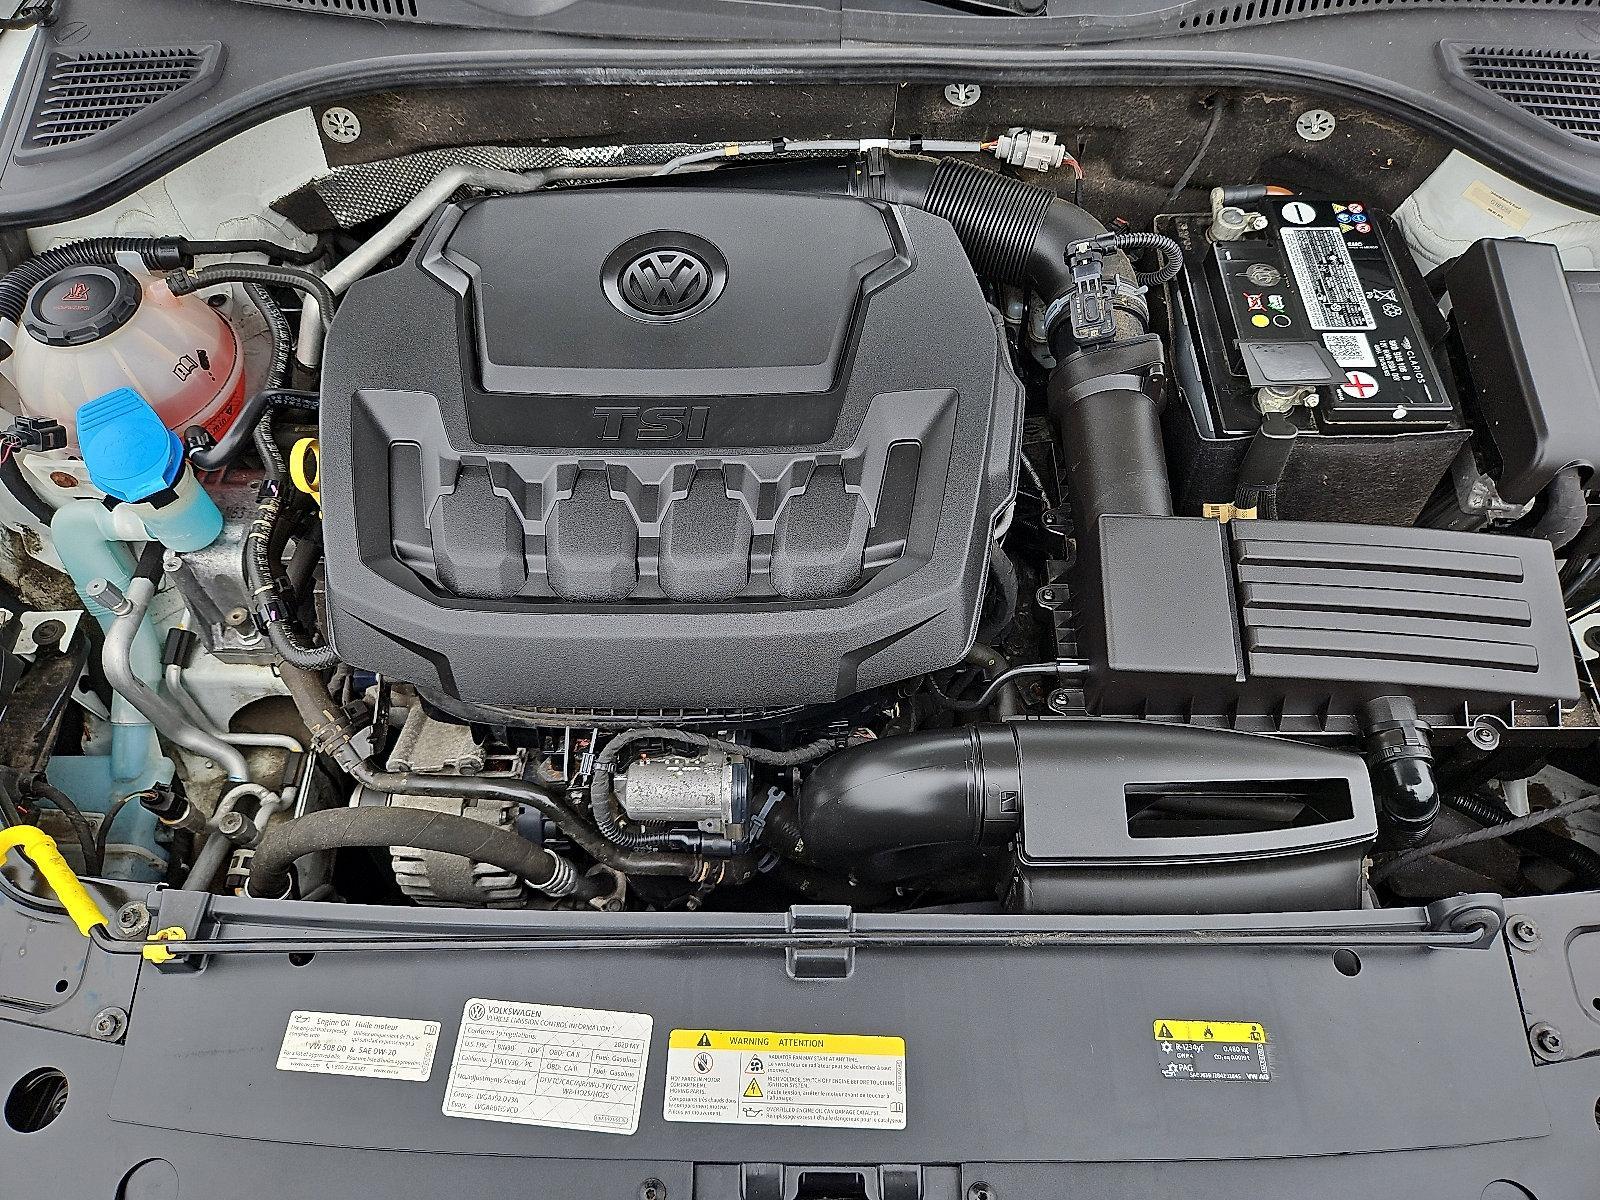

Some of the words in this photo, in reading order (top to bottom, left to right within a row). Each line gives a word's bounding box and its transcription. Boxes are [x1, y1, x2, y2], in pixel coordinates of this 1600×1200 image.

[1406, 350, 1426, 384] CLARIOS
[593, 406, 711, 441] TSI
[488, 1005, 542, 1018] VOLKSWAGEN
[316, 1017, 340, 1028] Engine
[340, 1019, 351, 1027] Oil
[354, 1020, 373, 1029] Huile
[373, 1023, 399, 1031] moteur
[540, 1019, 568, 1028] CONTROL
[568, 1022, 611, 1032] INFORMATION
[729, 1036, 769, 1046] WARNING
[779, 1038, 824, 1048] ATTENTION
[321, 1043, 336, 1052] 508
[336, 1044, 347, 1053] 00
[358, 1046, 373, 1055] SAE
[373, 1047, 397, 1056] 0W-20
[1175, 1042, 1205, 1054] R-1234yf
[1240, 1045, 1250, 1055] kg
[566, 1050, 576, 1058] CA
[611, 1055, 637, 1064] Gasoline
[563, 1064, 573, 1072] CA
[1178, 1063, 1194, 1072] PAG
[609, 1069, 635, 1078] Gasoline
